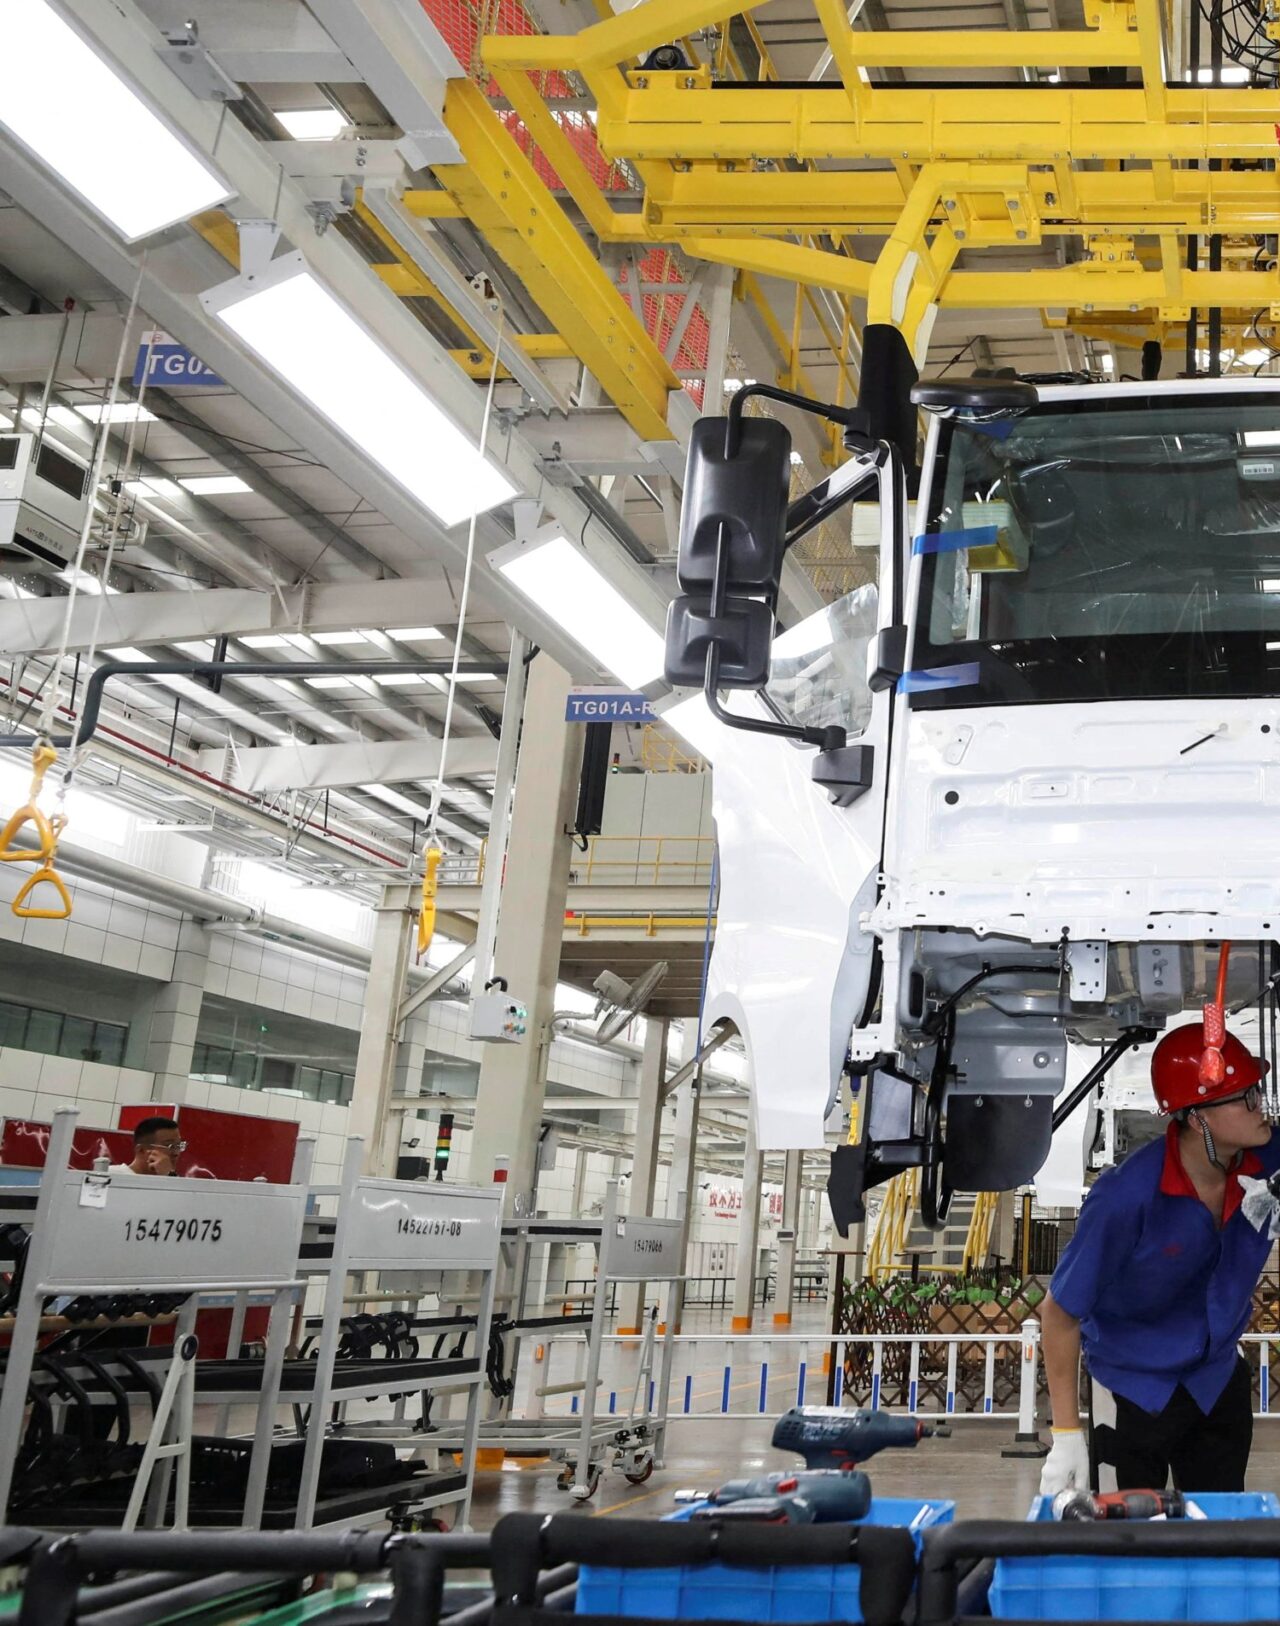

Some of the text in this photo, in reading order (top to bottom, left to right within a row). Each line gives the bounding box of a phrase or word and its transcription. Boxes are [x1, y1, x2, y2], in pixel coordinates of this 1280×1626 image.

[149, 354, 216, 375] TG0
[572, 701, 654, 715] TG01A-R
[125, 1218, 223, 1242] 15479075
[397, 1218, 462, 1236] 14522757-08
